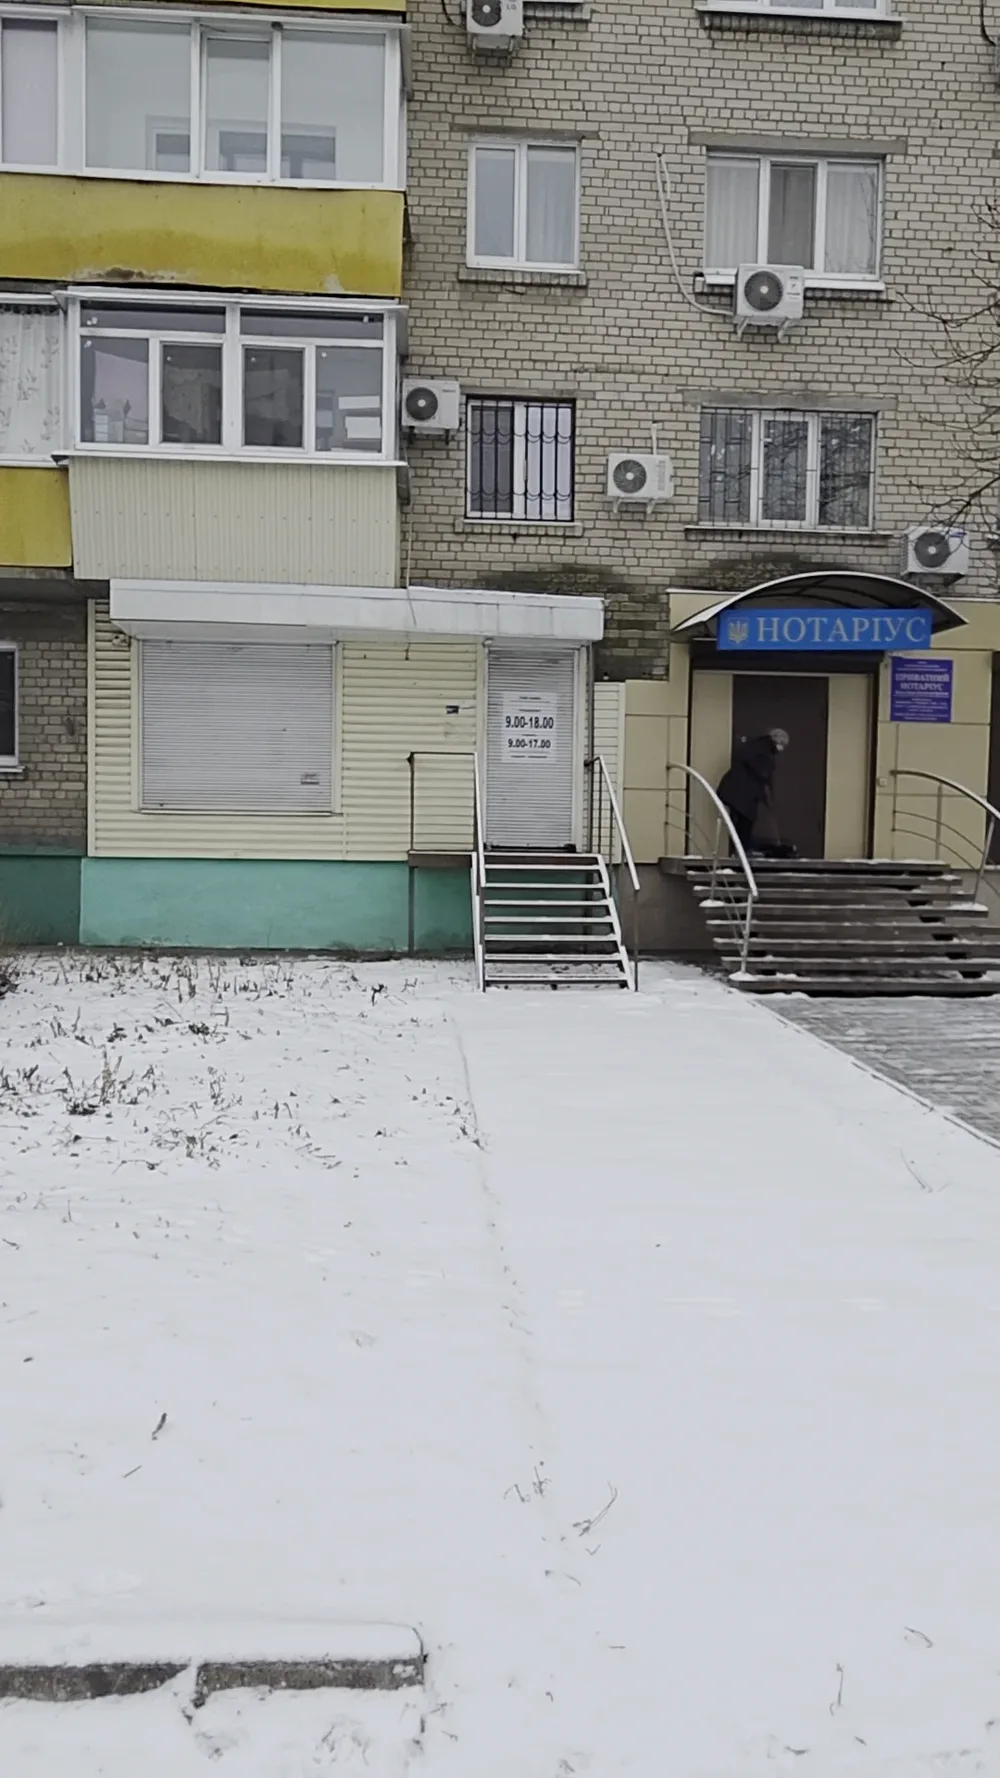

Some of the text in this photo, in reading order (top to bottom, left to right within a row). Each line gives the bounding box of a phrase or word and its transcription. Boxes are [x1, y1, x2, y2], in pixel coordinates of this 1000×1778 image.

[756, 616, 926, 643] НОТАРІУС
[505, 715, 554, 729] 9.00-18.00
[507, 738, 551, 749] 9.00-17.00
